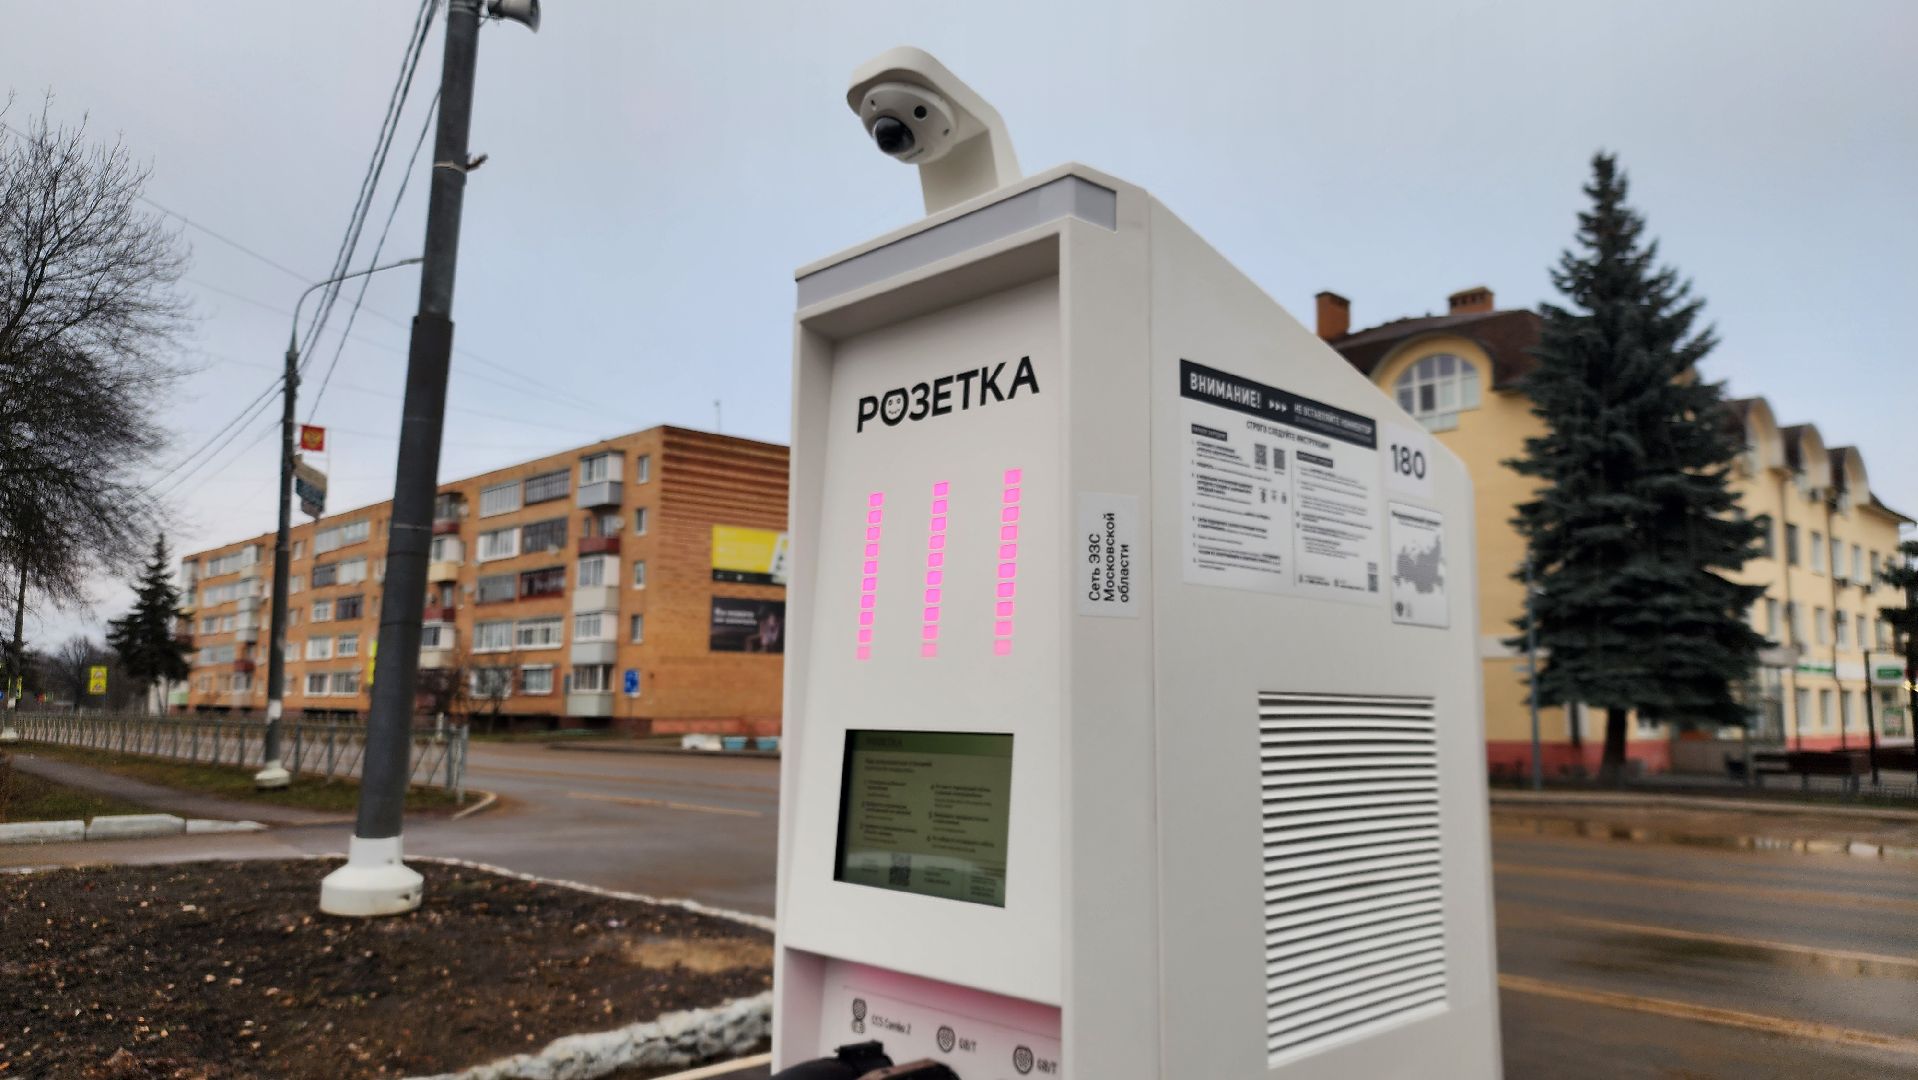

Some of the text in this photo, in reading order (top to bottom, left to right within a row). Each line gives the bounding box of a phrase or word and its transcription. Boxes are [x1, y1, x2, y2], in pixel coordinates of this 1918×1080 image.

[857, 356, 1040, 433] РОЗЕТКА
[1190, 372, 1261, 409] ВНИМАНИЕ!
[1390, 444, 1426, 480] 180
[1088, 533, 1101, 602] Сеть ЭЗС
[1103, 512, 1115, 602] Московской
[1117, 543, 1129, 603] области
